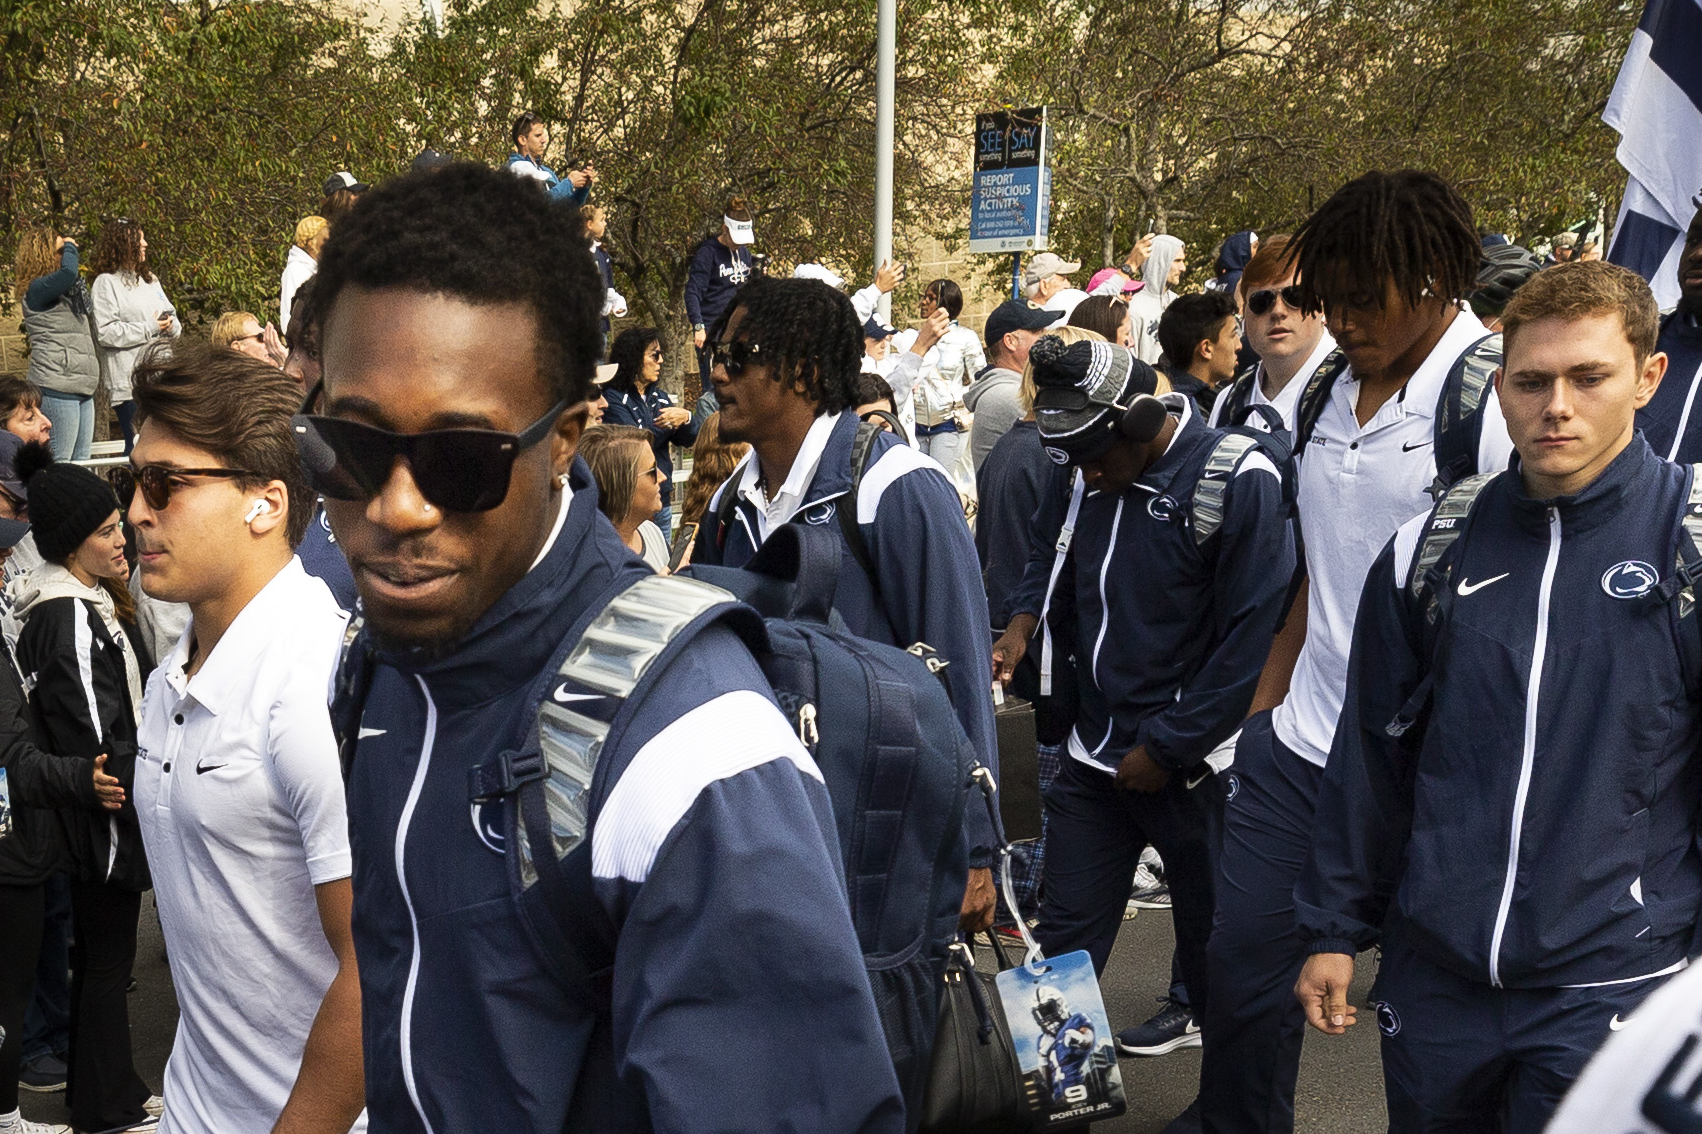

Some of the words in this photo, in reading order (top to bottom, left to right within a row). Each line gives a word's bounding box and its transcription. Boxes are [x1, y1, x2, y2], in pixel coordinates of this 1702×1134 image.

[980, 130, 1003, 152] SEE
[1011, 127, 1037, 149] SAY
[980, 173, 1014, 186] REPORT
[979, 184, 1031, 199] SUSPICIOUS
[1431, 518, 1457, 530] PSU
[1064, 1084, 1088, 1103] 9
[1050, 1105, 1094, 1120] PORTER
